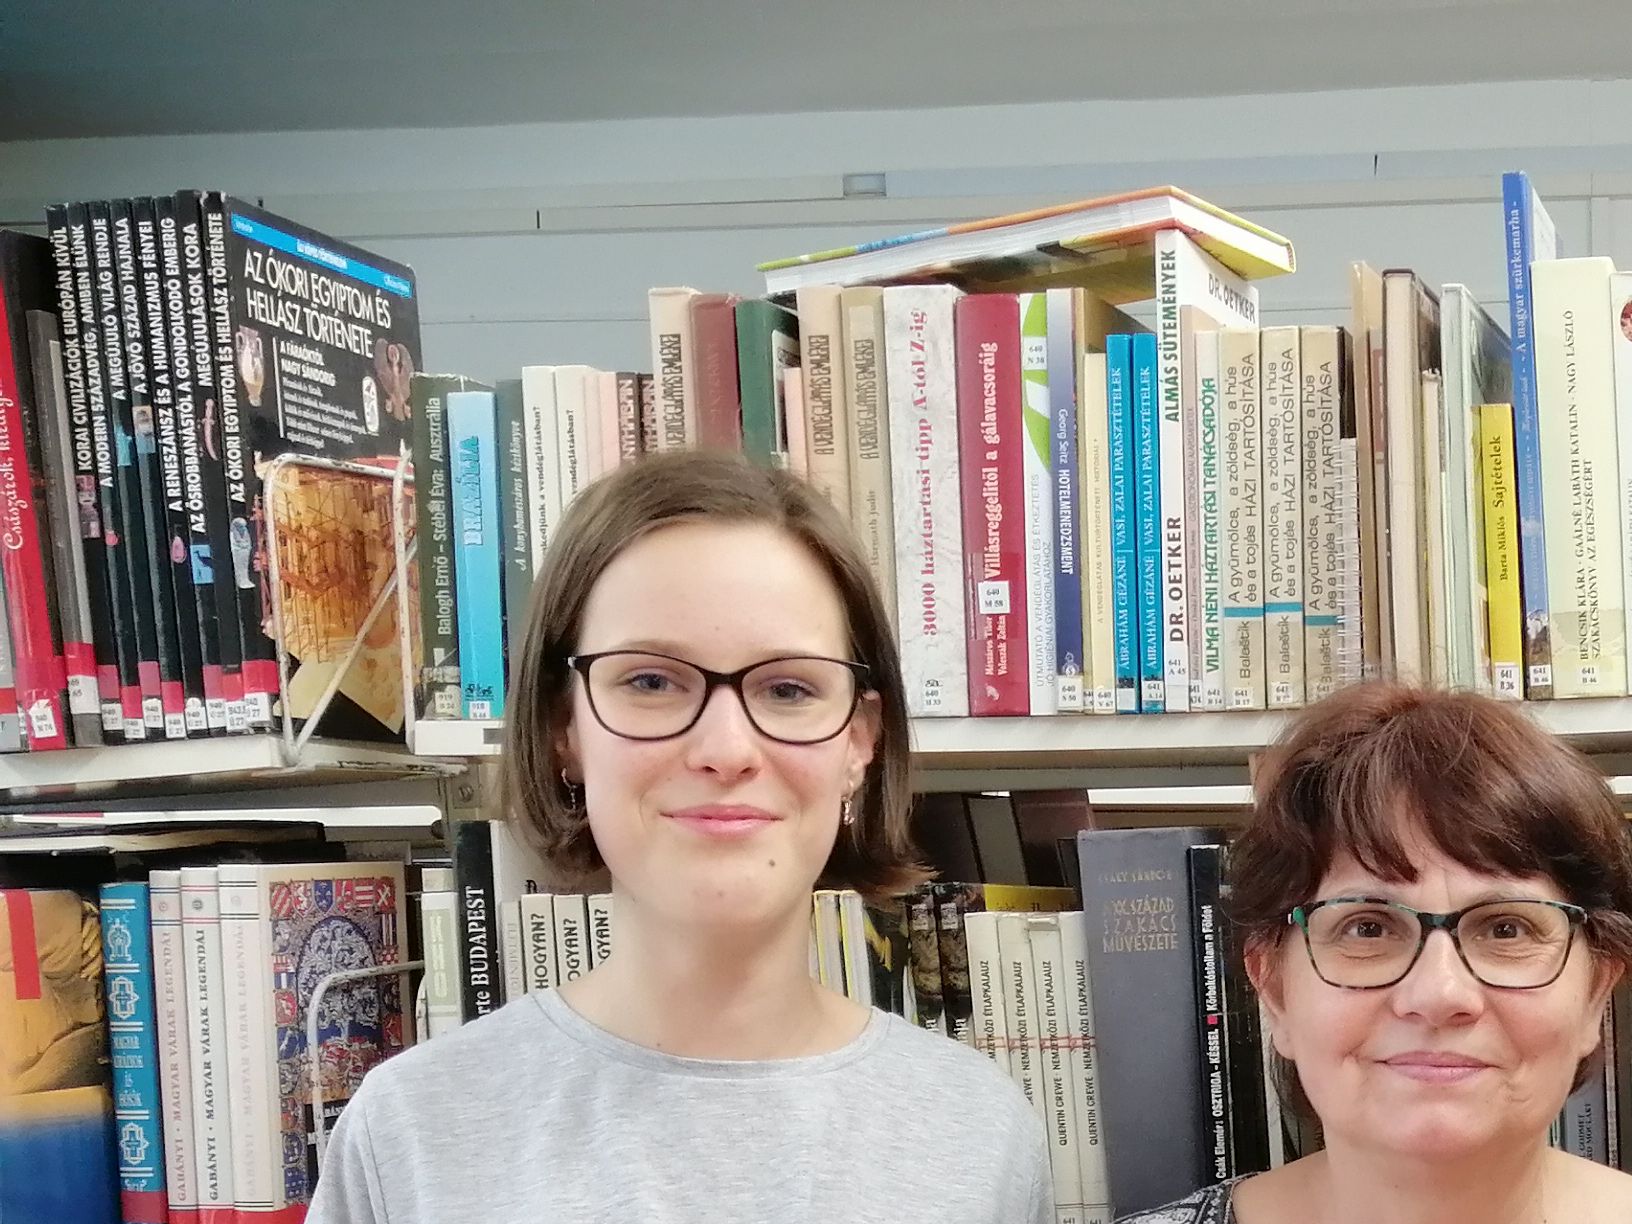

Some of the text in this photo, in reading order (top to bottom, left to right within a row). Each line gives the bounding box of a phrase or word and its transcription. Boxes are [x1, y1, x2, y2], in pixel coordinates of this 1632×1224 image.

[93, 218, 111, 268] RENDJE
[115, 218, 140, 338] SZÁZAD HAJNALA
[160, 217, 190, 379] GONDOLKODÓ EMBERIG
[183, 223, 201, 268] KORA
[245, 248, 265, 284] AZ
[265, 248, 308, 298] ÓKORI
[311, 273, 375, 323] EGYIPTOM
[376, 288, 391, 329] ÉS
[1208, 274, 1255, 322] DR. OETKER
[56, 270, 92, 471] KORAI CIVILIZÁCIÓK EURÓPÁN
[77, 272, 112, 475] MODERN AMIBEN
[247, 288, 374, 358] HELLÁSZ TÖRTÉNETE
[1157, 249, 1181, 423] ALMÁS SÜTEMÉNYEK
[1514, 293, 1527, 339] magyar
[144, 272, 182, 497] RENESZÁNSZ HUMANIZMUS
[220, 365, 246, 503] AZ ÓKORI EGYIPTOM
[979, 342, 1000, 444] gálavacsoráig
[1241, 353, 1257, 515] HÁZI TARTÓSÍTÁSA
[1281, 348, 1296, 465] TARTÓSÍTÁSA
[425, 397, 453, 635] Balogh Ausztrália
[916, 418, 938, 636] 3000 tipp
[1056, 408, 1074, 575] Georg HOTELMENEDZSMENT
[1489, 435, 1508, 508] Sajtételek
[1562, 310, 1588, 660] BENCSIK KATALIN NAGY LÁSZLÓ
[1168, 517, 1184, 643] DR. OETKER
[1206, 619, 1220, 673] VILMA
[465, 886, 490, 986] BUDAPEST
[531, 913, 549, 989] HOGYAN?
[980, 960, 995, 1017] ÉTLAPKALAUZ
[1013, 961, 1027, 1017] ÉTLAPKALAUZ
[170, 1063, 182, 1120] MAGYAR
[195, 930, 218, 1200] GABÁNYI MAGYAR VÁRAK LEGENDÁI
[1043, 960, 1068, 1146] QUENTIN CREWE ÉTLAPKALAUZ
[1075, 959, 1099, 1146] QUENTIN CREWE ÉTLAPKALAUZ
[1208, 1028, 1221, 1064] KÉSSEL
[1211, 1071, 1224, 1117] OSZTRIGA
